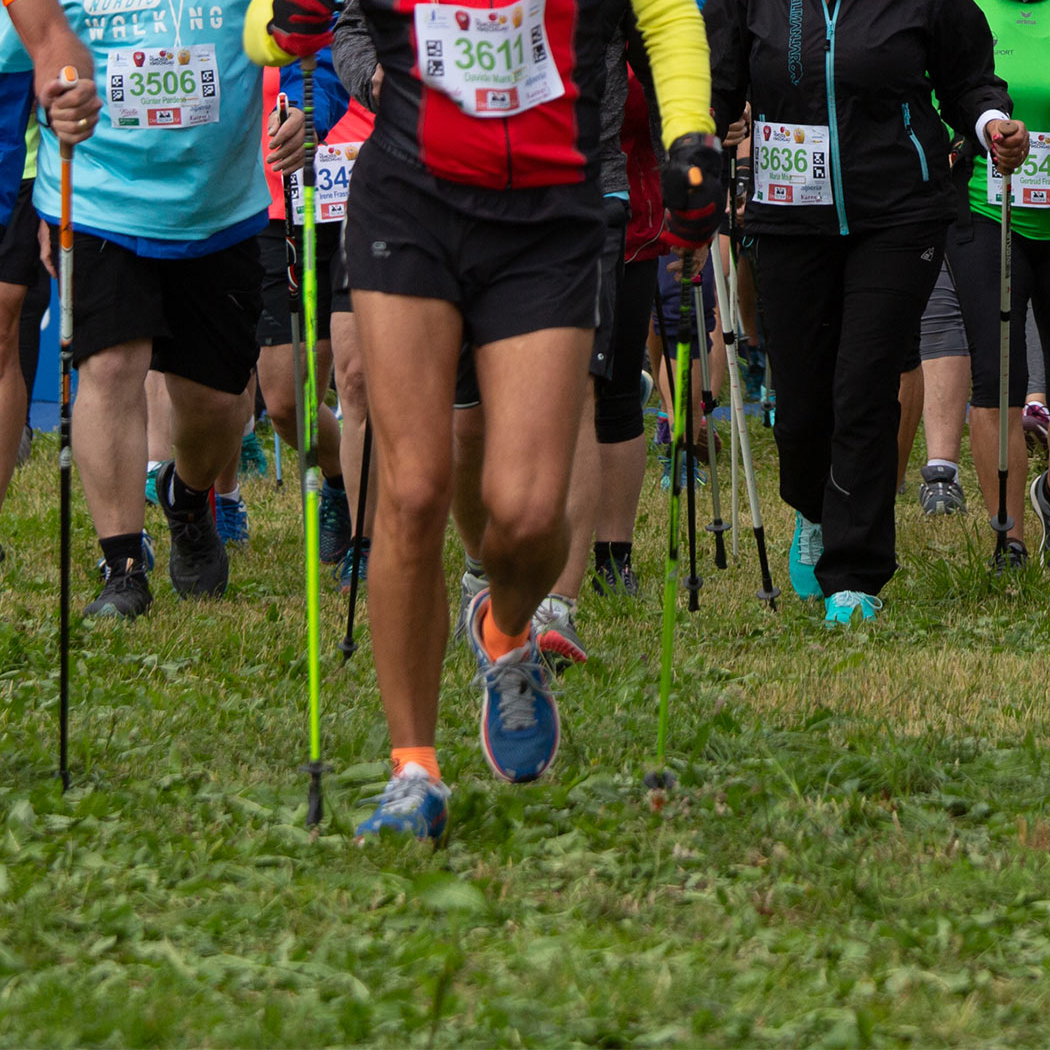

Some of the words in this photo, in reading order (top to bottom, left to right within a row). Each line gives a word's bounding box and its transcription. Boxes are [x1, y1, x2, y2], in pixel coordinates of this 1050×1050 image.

[455, 33, 524, 71] 3611
[129, 69, 197, 97] 3506
[760, 146, 808, 173] 3636
[315, 165, 352, 191] 34
